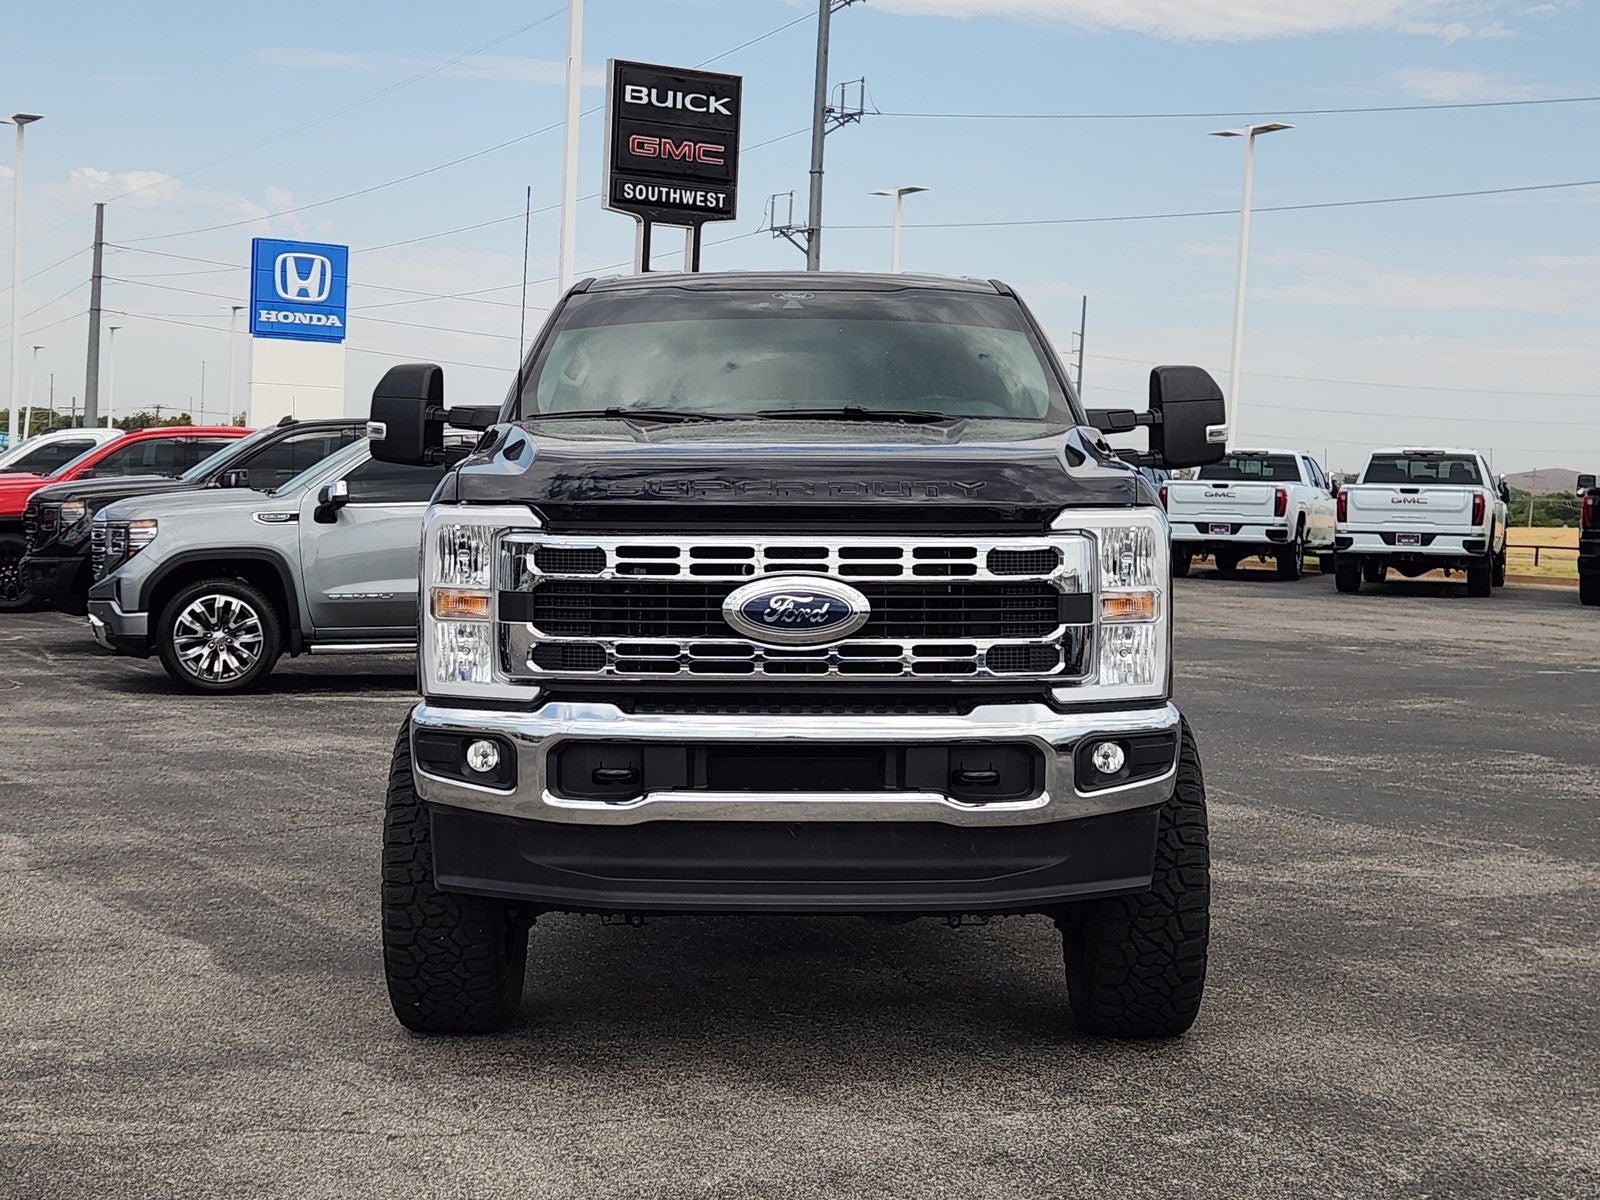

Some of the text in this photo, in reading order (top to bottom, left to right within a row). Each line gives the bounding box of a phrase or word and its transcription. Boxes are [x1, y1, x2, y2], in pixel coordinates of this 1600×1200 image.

[624, 84, 733, 116] BUICK
[628, 134, 725, 166] GMC
[623, 183, 727, 209] SOUTHWEST
[258, 310, 344, 327] HONDA
[828, 479, 988, 498] DUTY
[1204, 491, 1237, 499] GMC
[1391, 497, 1429, 505] GMC
[763, 594, 831, 623] Ford
